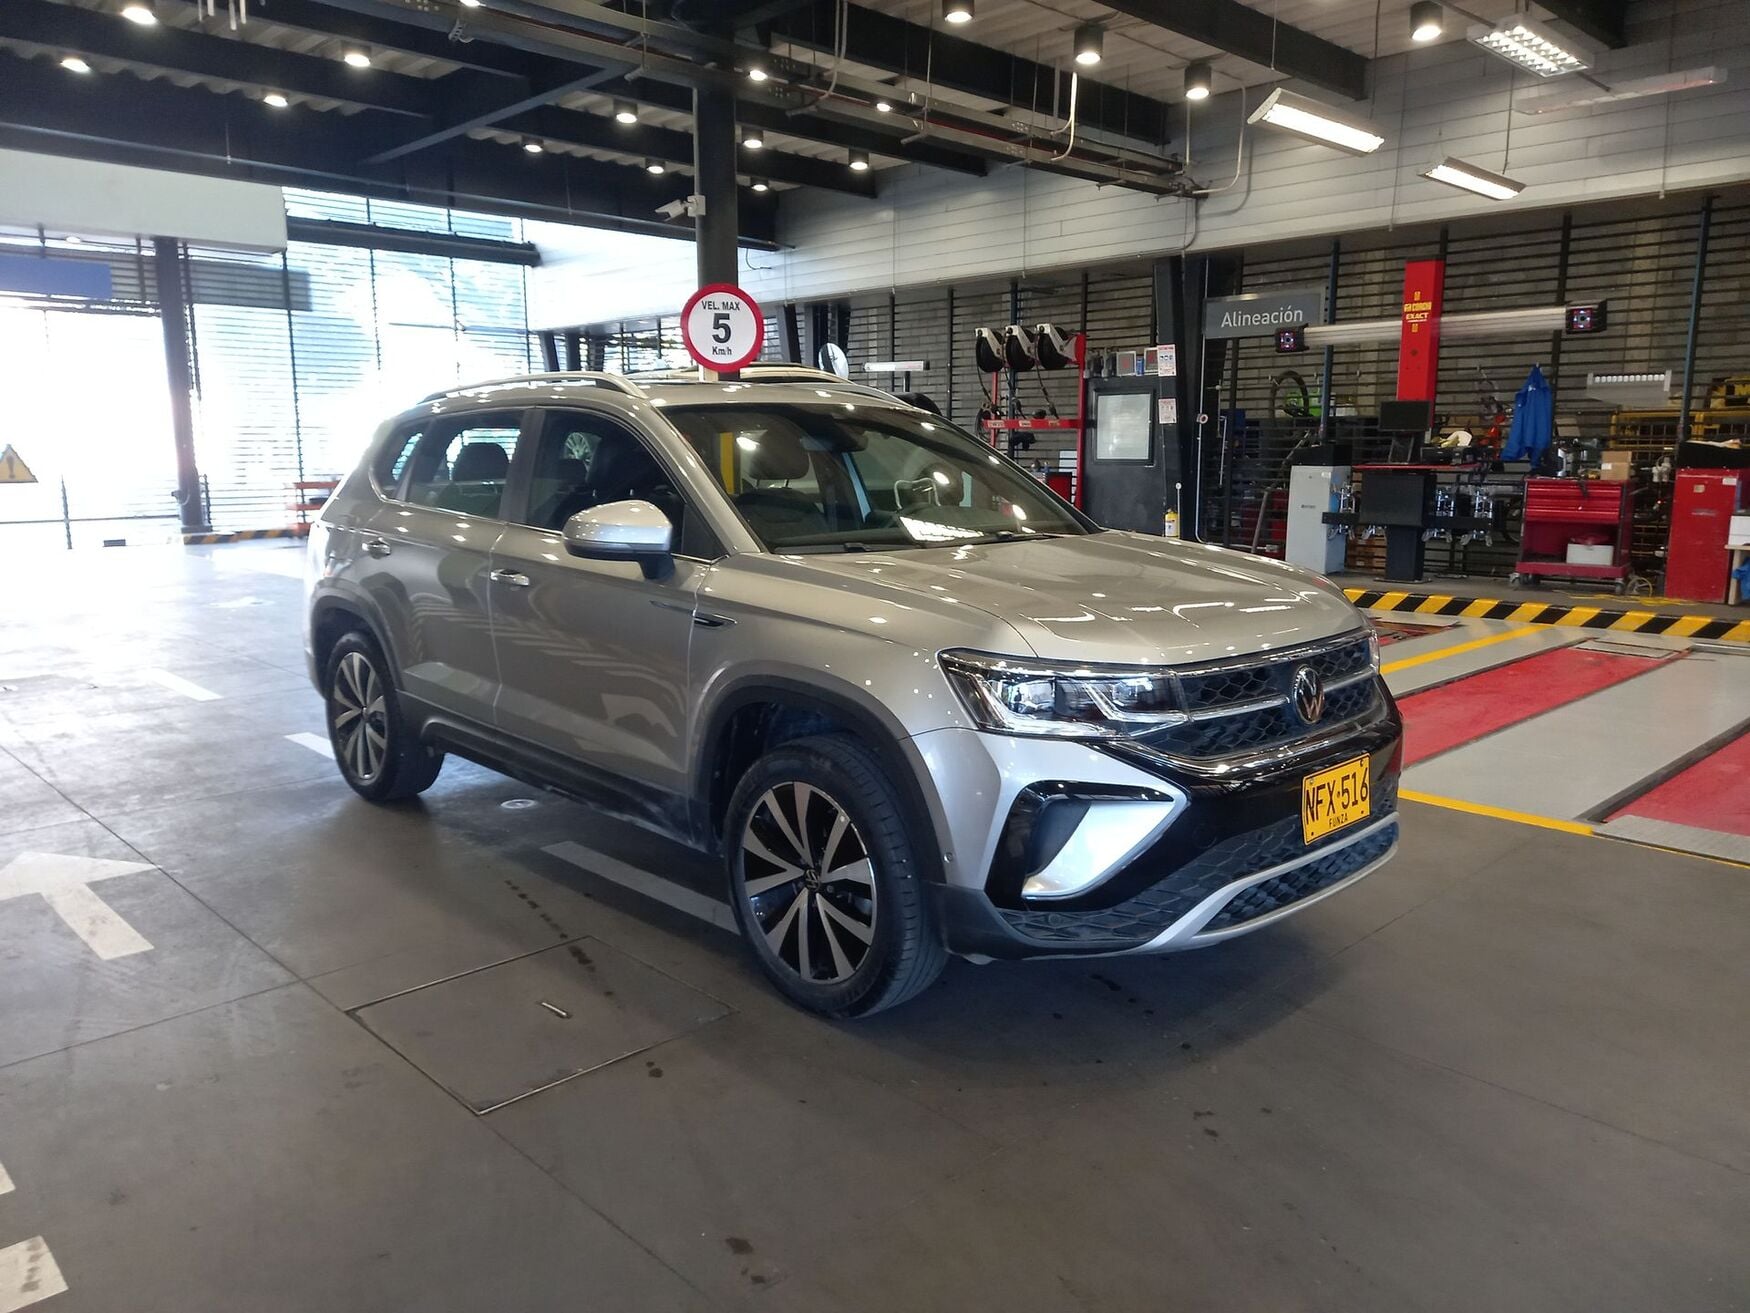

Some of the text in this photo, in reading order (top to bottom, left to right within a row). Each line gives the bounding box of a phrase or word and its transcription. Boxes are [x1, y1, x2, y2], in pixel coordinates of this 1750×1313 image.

[702, 301, 740, 310] VEL. MAX
[1221, 305, 1303, 328] Alineación
[712, 313, 731, 343] 5
